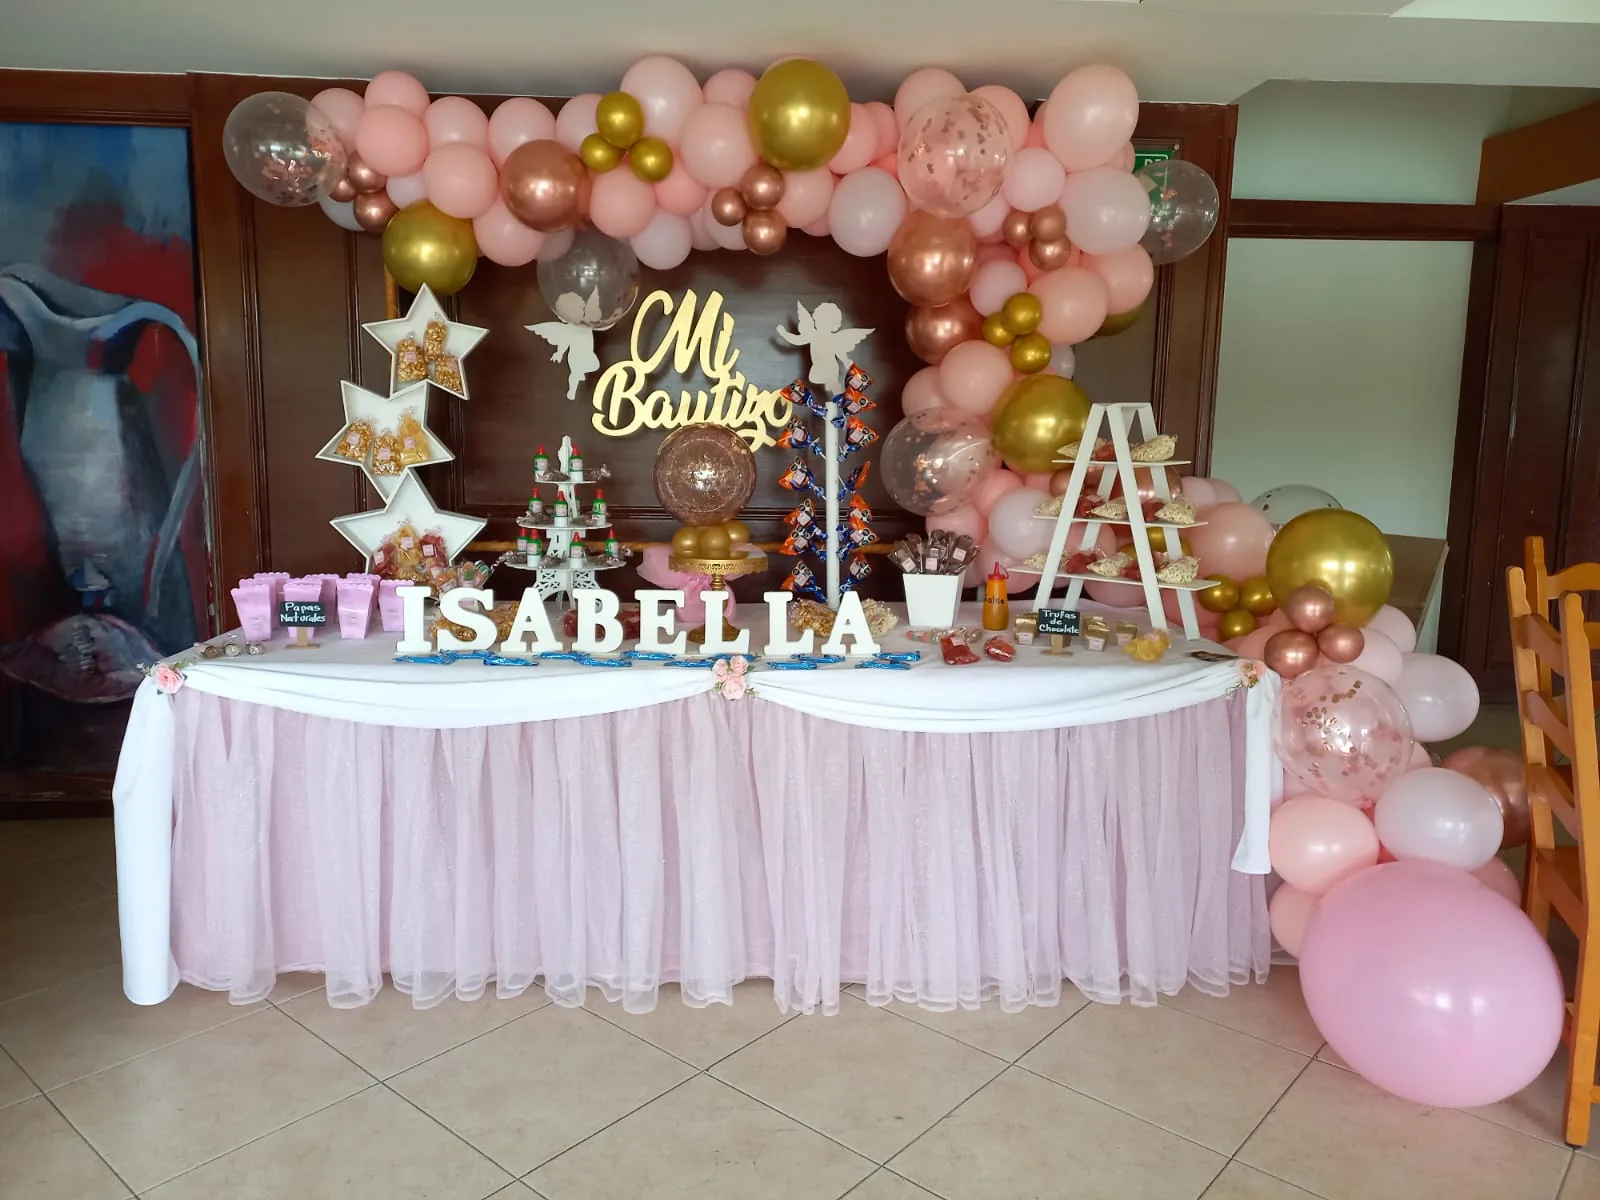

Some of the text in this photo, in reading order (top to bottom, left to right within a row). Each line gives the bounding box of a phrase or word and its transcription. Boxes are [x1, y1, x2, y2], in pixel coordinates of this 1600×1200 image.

[630, 288, 741, 379] Mi
[591, 360, 793, 453] Bautizo
[284, 602, 321, 614] Papas
[280, 611, 326, 623] Naturales
[395, 585, 881, 655] ISABELLA
[1041, 609, 1077, 620] Trufas
[1050, 617, 1063, 625] de
[1038, 623, 1080, 634] Chocolate
